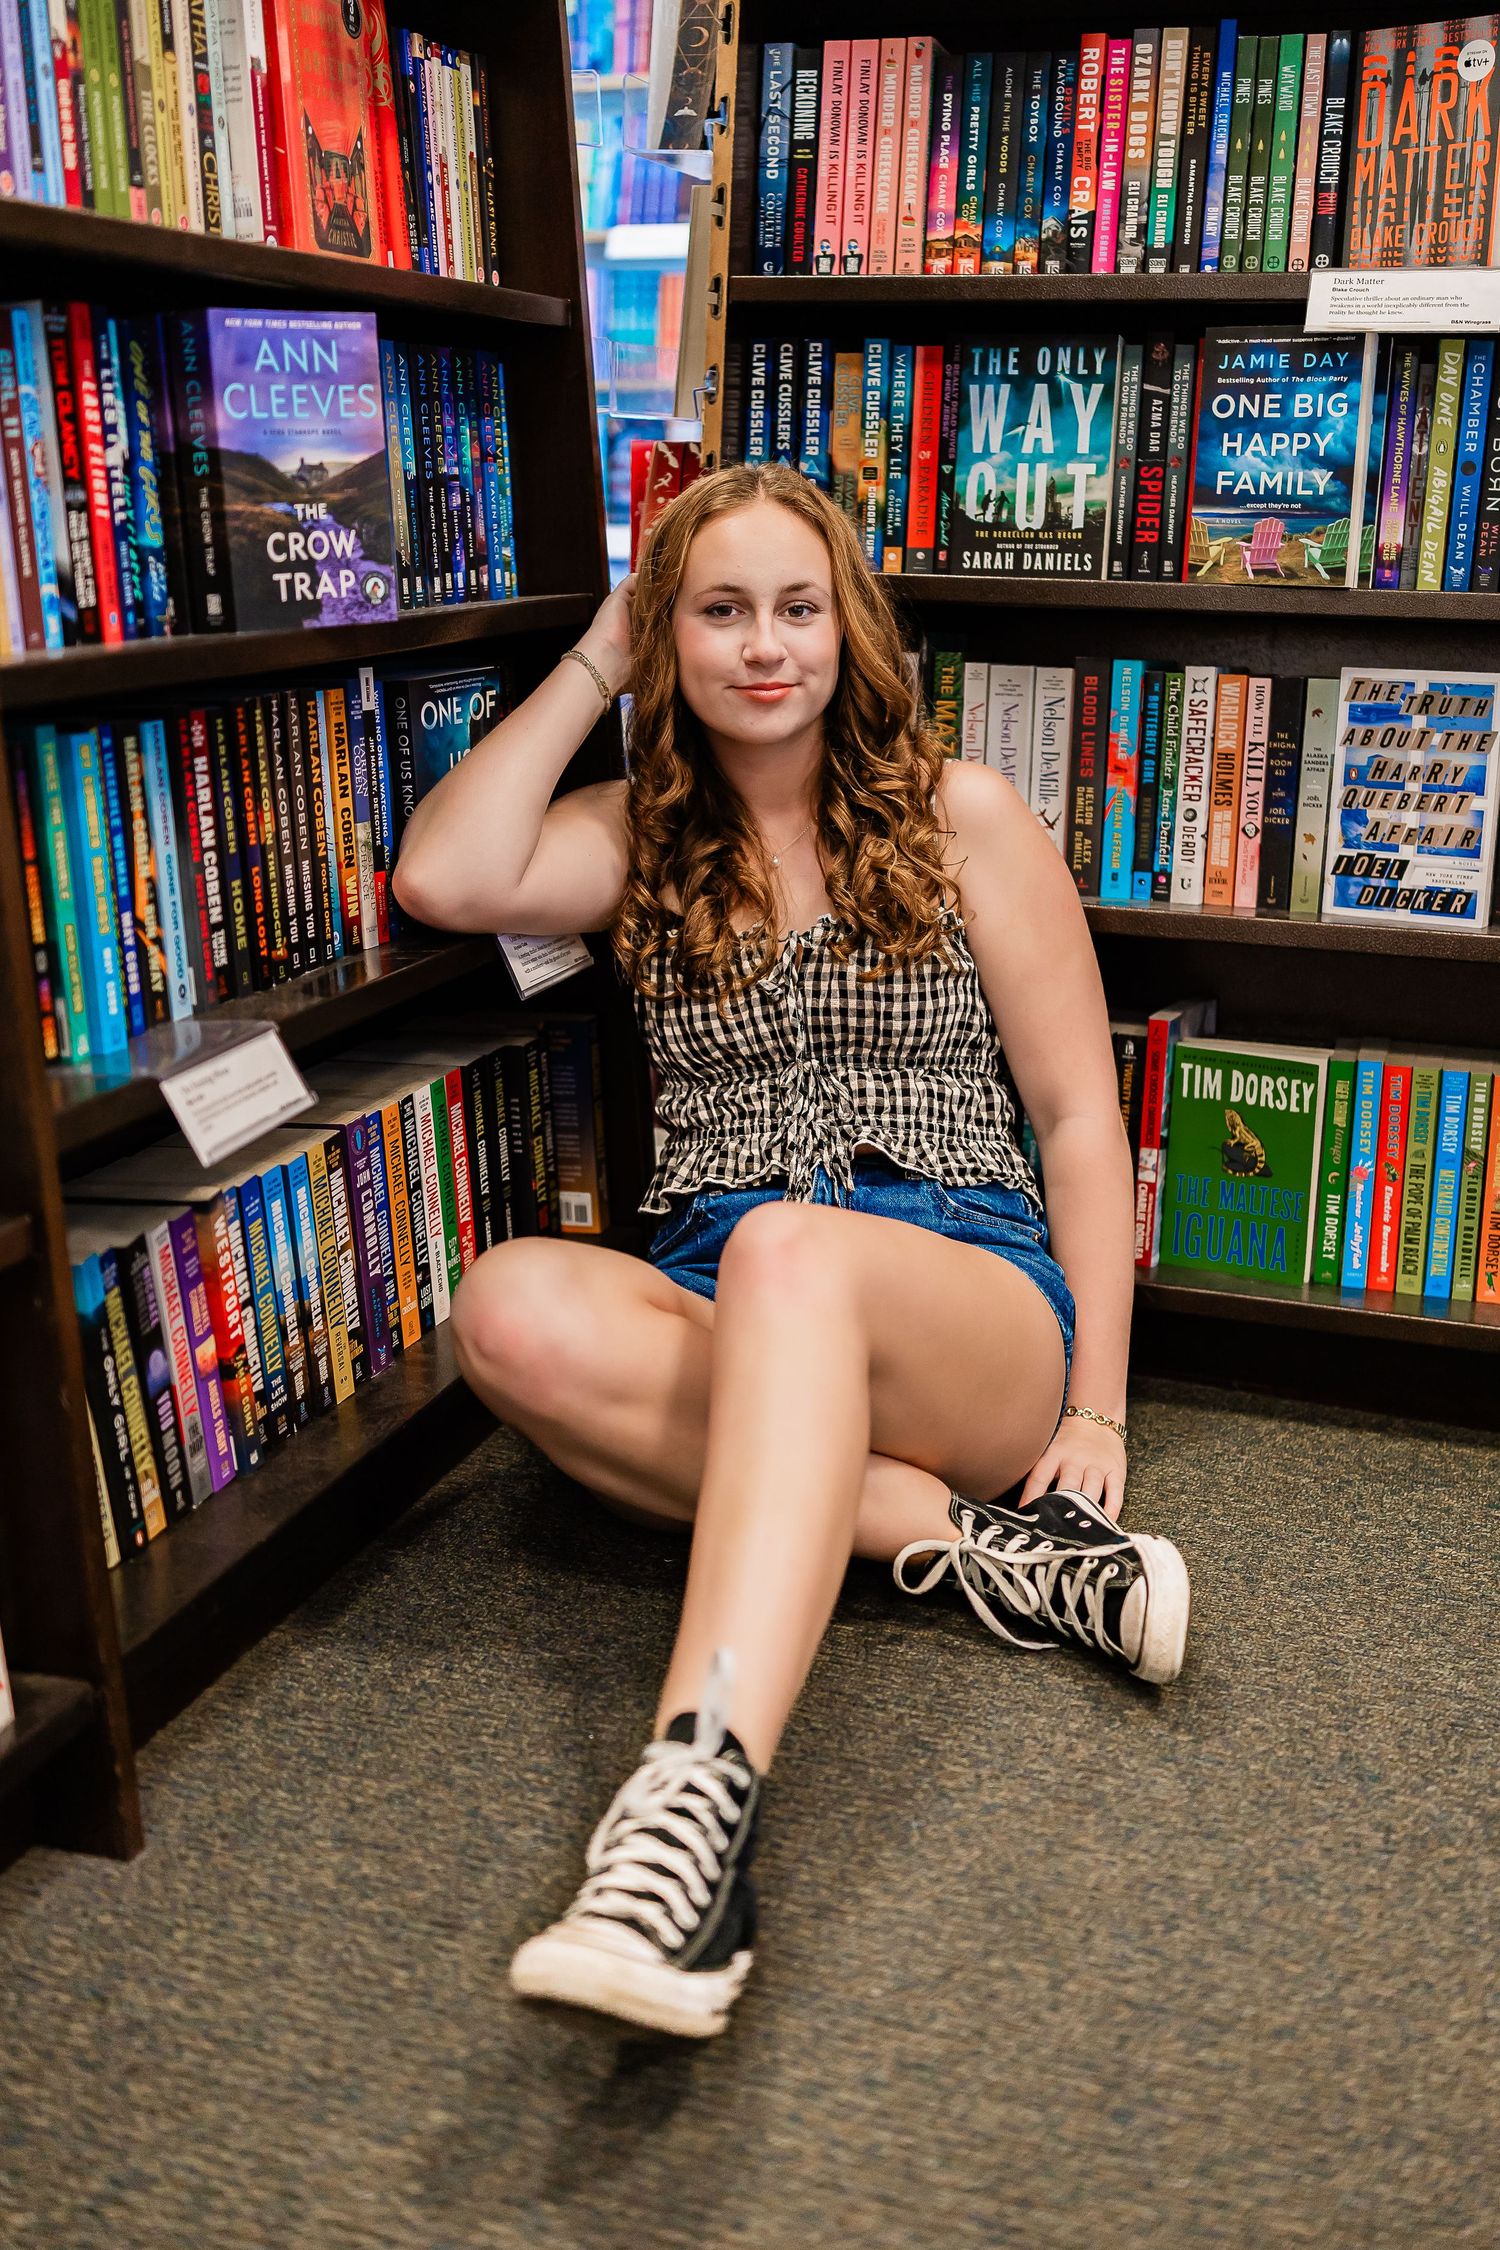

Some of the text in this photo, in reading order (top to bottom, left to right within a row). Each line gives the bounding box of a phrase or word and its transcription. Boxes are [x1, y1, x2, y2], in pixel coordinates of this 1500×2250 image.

[793, 70, 818, 140] RECKONING
[1077, 48, 1100, 132] ROBERT
[1279, 65, 1296, 111] WAYWARD
[1303, 45, 1321, 117] THE LAST TOWN
[1358, 66, 1496, 148] DARK
[765, 71, 782, 179] LAST SECOND
[825, 60, 844, 225] FINLAY DONOVAN IS KILLING IT
[1000, 67, 1014, 173] ALONE IN THE WOODS
[1102, 48, 1125, 190] THE SISTER-IN-LAW
[1124, 43, 1152, 238] OZARK DOGS ELI CRANOR
[1076, 142, 1084, 169] EMPTY
[1083, 154, 1091, 170] BIG
[1224, 78, 1251, 239] PINES BLAKE CROUCH
[1354, 141, 1491, 196] MATTER
[1069, 176, 1092, 238] CRAIS
[1351, 218, 1485, 250] BLAKE CROUCH
[431, 224, 439, 268] MURDERS
[255, 338, 338, 373] ANN
[971, 347, 1107, 375] THE ONLY
[1130, 365, 1139, 382] THE
[1219, 352, 1350, 369] JAMIE DAY
[223, 383, 378, 420] CLEEVES
[398, 354, 414, 480] ANN CLEEVES
[864, 344, 882, 457] CLIVE CUSSLER
[889, 354, 906, 479] WHERE THEY LIE
[1119, 371, 1131, 445] TO OUR FRIENDS
[1129, 383, 1138, 416] THINGS
[1212, 393, 1348, 419] ONE BIG
[1437, 352, 1461, 428] DAY ONE
[1465, 363, 1486, 453] CHAMBER
[56, 391, 81, 479] CLANCY
[969, 384, 1104, 454] WAY
[1127, 418, 1136, 434] WE
[1222, 432, 1334, 456] HAPPY
[965, 462, 1097, 530] OUT
[1135, 466, 1164, 543] SPIDER
[1216, 471, 1334, 495] FAMILY
[294, 503, 328, 521] THE
[266, 530, 356, 563] CROW
[962, 552, 1093, 571] SARAH DANIELS
[272, 569, 356, 602] TRAP
[420, 690, 497, 730] ONE OF
[1217, 682, 1240, 749] WARLOCK
[1256, 685, 1265, 712] HOW
[1351, 681, 1489, 716] THE TRUTH
[1038, 697, 1066, 804] Nelson DeMille
[1080, 676, 1098, 778] BLOOD LINES
[1163, 679, 1181, 779] The Child Finder
[1183, 699, 1208, 802] SAFECRACKER
[1342, 728, 1492, 752] ABOUT THE
[1214, 753, 1235, 806] HOLMES
[1246, 741, 1265, 787] KILL
[1371, 760, 1465, 784] HARRY
[288, 697, 316, 939] HARLAN COBEN MISSING YOU
[379, 783, 389, 837] WATCHING
[1245, 791, 1260, 820] YOU
[1342, 788, 1470, 814] QUEBERT
[193, 756, 224, 924] HARLAN COBEN
[1366, 822, 1476, 848] AFFAIR
[1335, 856, 1404, 879] JOEL
[231, 880, 247, 950] HOME
[320, 862, 332, 940] FOOL ME ONCE
[343, 875, 359, 918] WIN
[1360, 887, 1467, 913] DICKER
[1181, 1062, 1222, 1100] TIM
[1230, 1073, 1315, 1113] DORSEY
[1176, 1174, 1305, 1222] THE MALTESE
[329, 1168, 360, 1331] MICHAEL CONNELLY
[359, 1188, 382, 1278] CONNOLLY
[1173, 1210, 1287, 1272] IGUANA
[1459, 1175, 1479, 1278] FLORIDA ROADKILL
[213, 1214, 243, 1340] WESTPORT
[434, 1250, 443, 1276] BLACK
[334, 1330, 346, 1372] REVERSAL
[156, 1390, 184, 1492] VOID MOON
